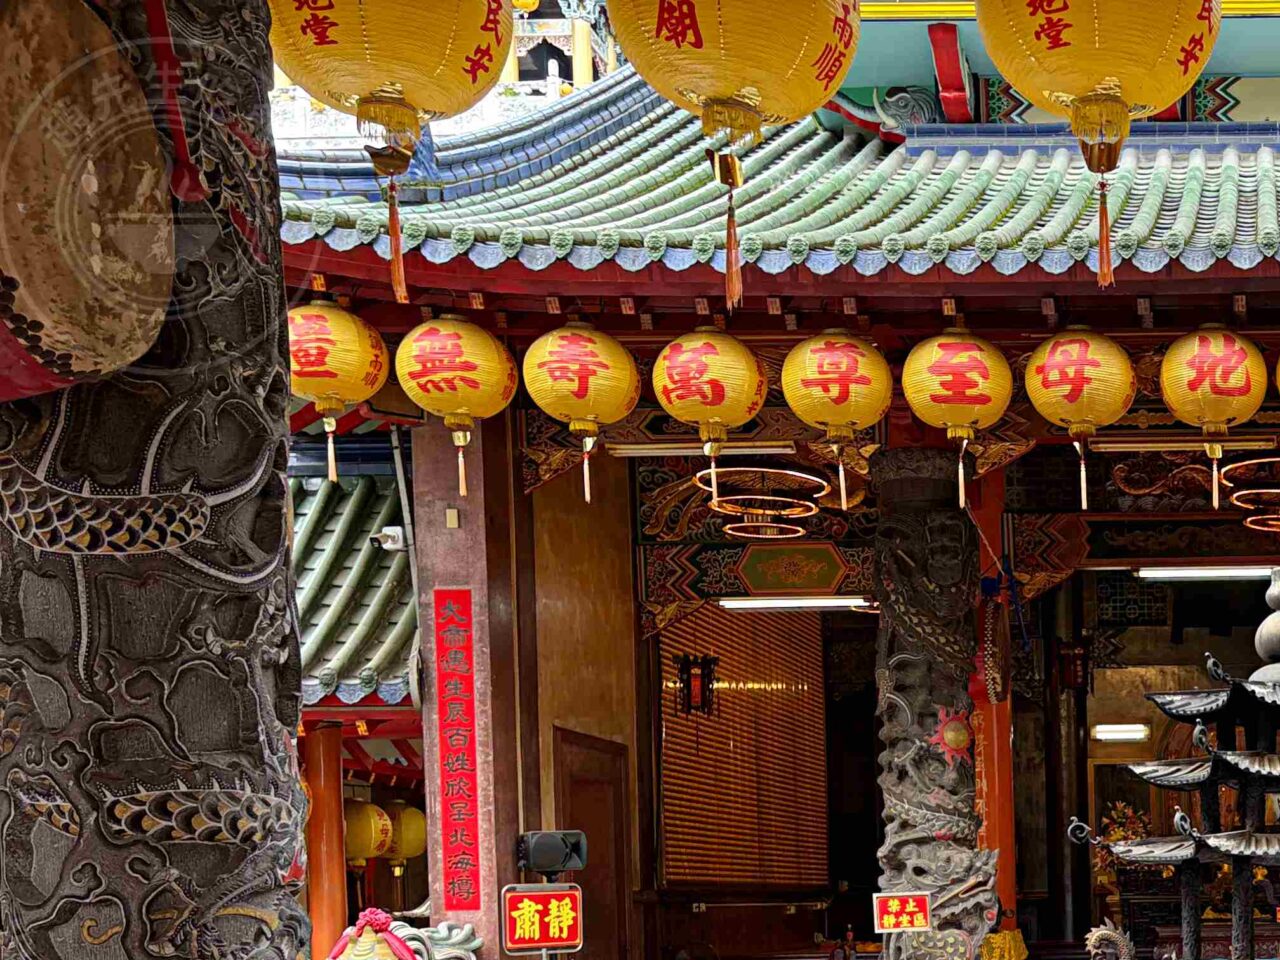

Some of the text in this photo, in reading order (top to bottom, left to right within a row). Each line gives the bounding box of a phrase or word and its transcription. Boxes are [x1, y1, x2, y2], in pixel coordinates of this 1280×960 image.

[408, 327, 481, 394] 無
[537, 333, 610, 400] 壽
[661, 342, 726, 407] 萬
[800, 340, 873, 405] 尊
[927, 342, 992, 405] 至
[1035, 338, 1101, 403] 母
[1186, 334, 1252, 397] 地
[510, 896, 577, 941] 肅靜
[887, 898, 919, 913] 禁止
